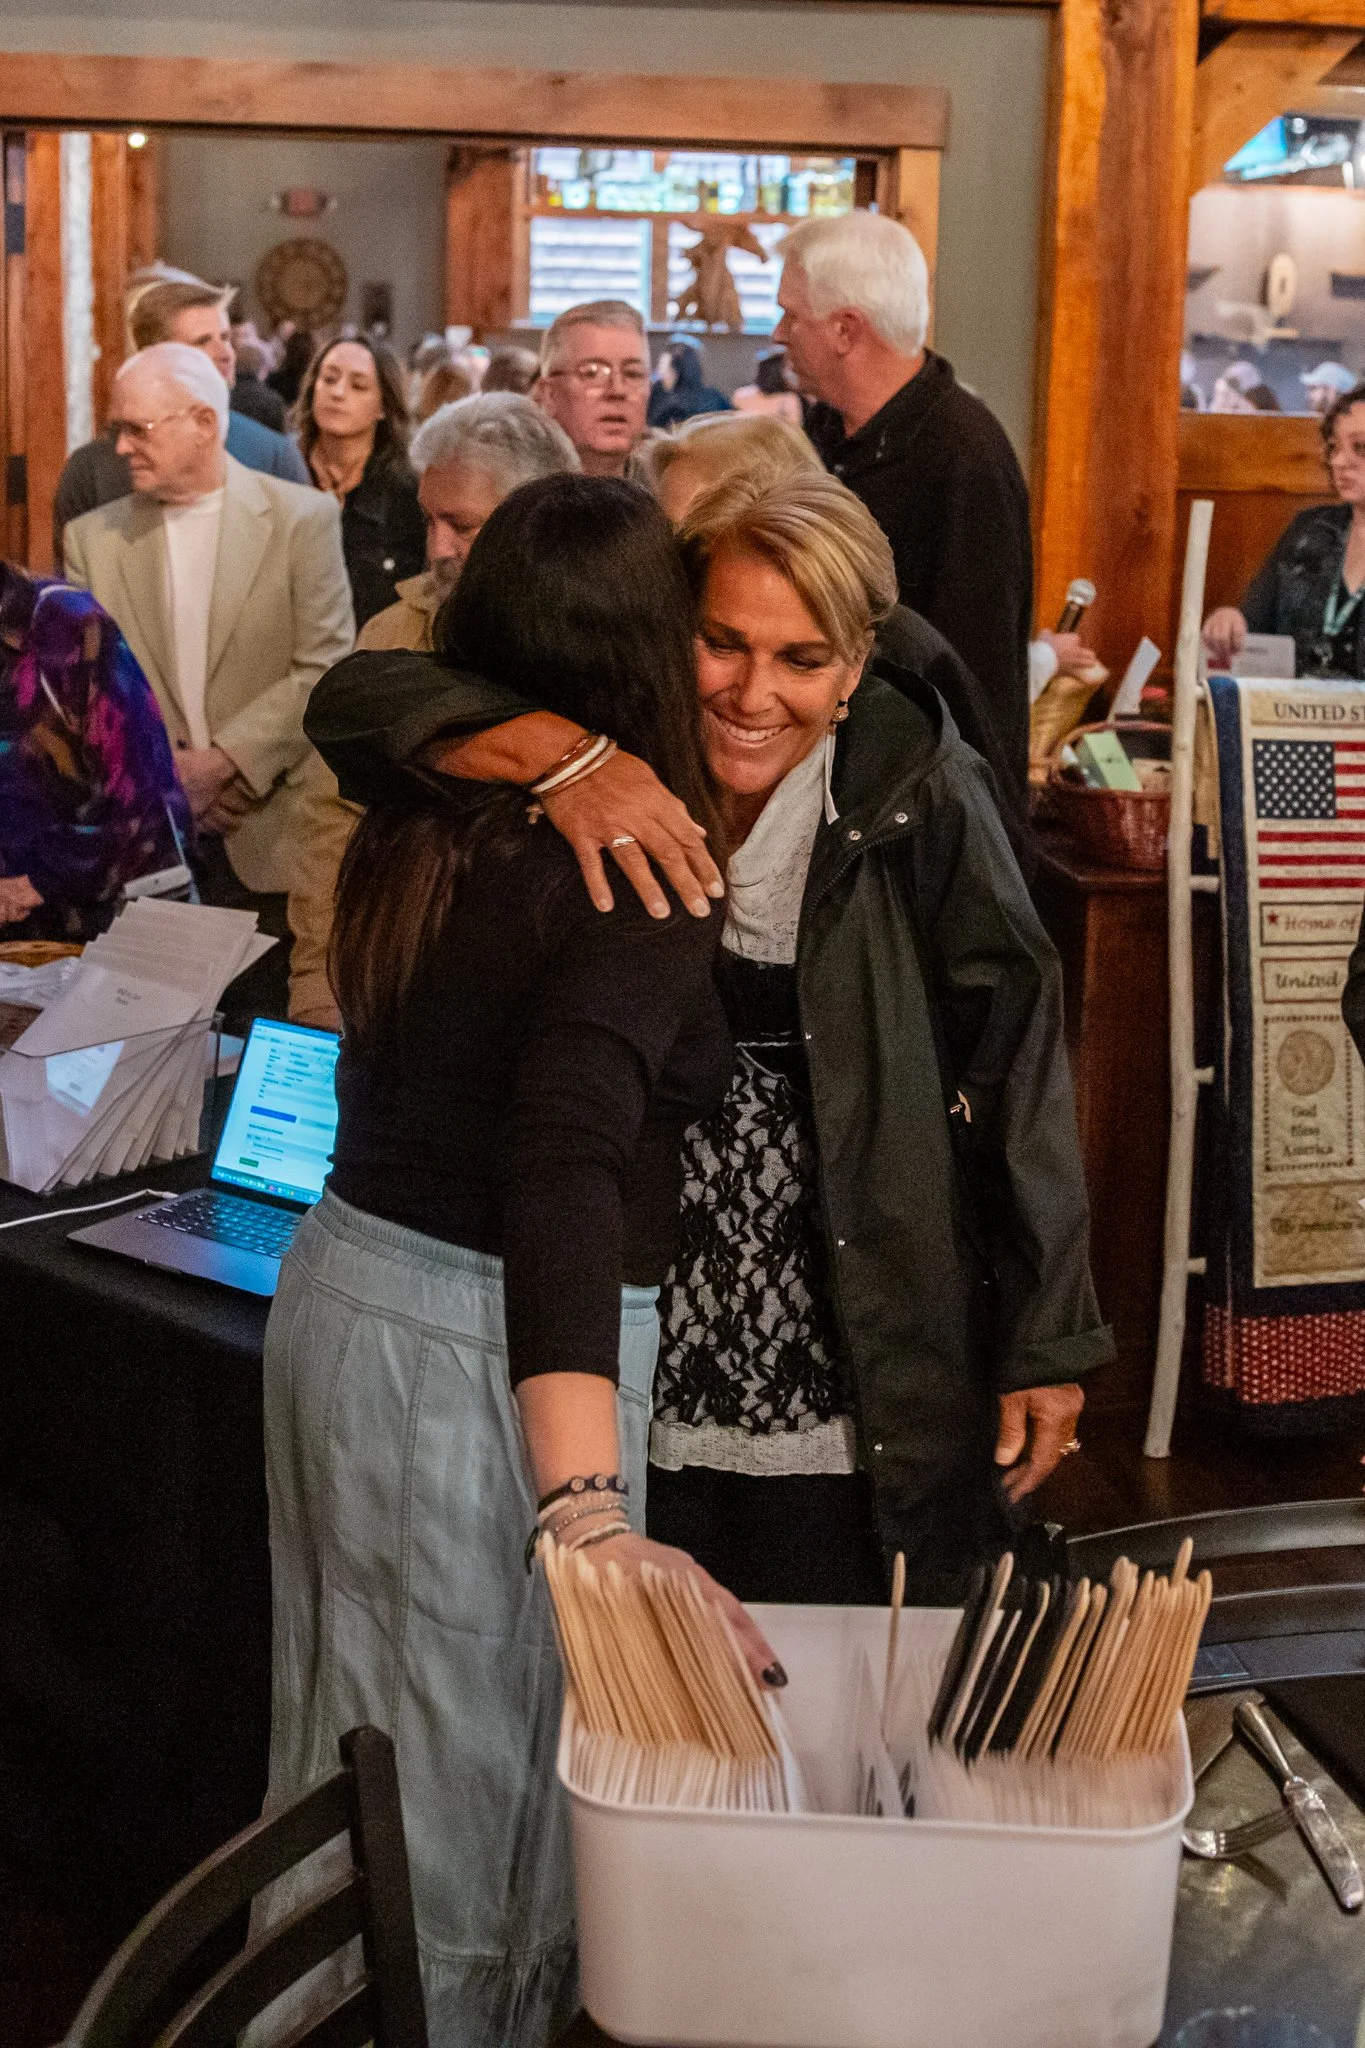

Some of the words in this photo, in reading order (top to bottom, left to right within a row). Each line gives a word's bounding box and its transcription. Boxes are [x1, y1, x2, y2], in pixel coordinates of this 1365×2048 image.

[1273, 703, 1346, 720] UNITED
[1285, 915, 1336, 931] Home
[1339, 914, 1358, 933] of
[1276, 971, 1340, 989] United
[1292, 1104, 1317, 1118] God
[1283, 1144, 1333, 1157] America
